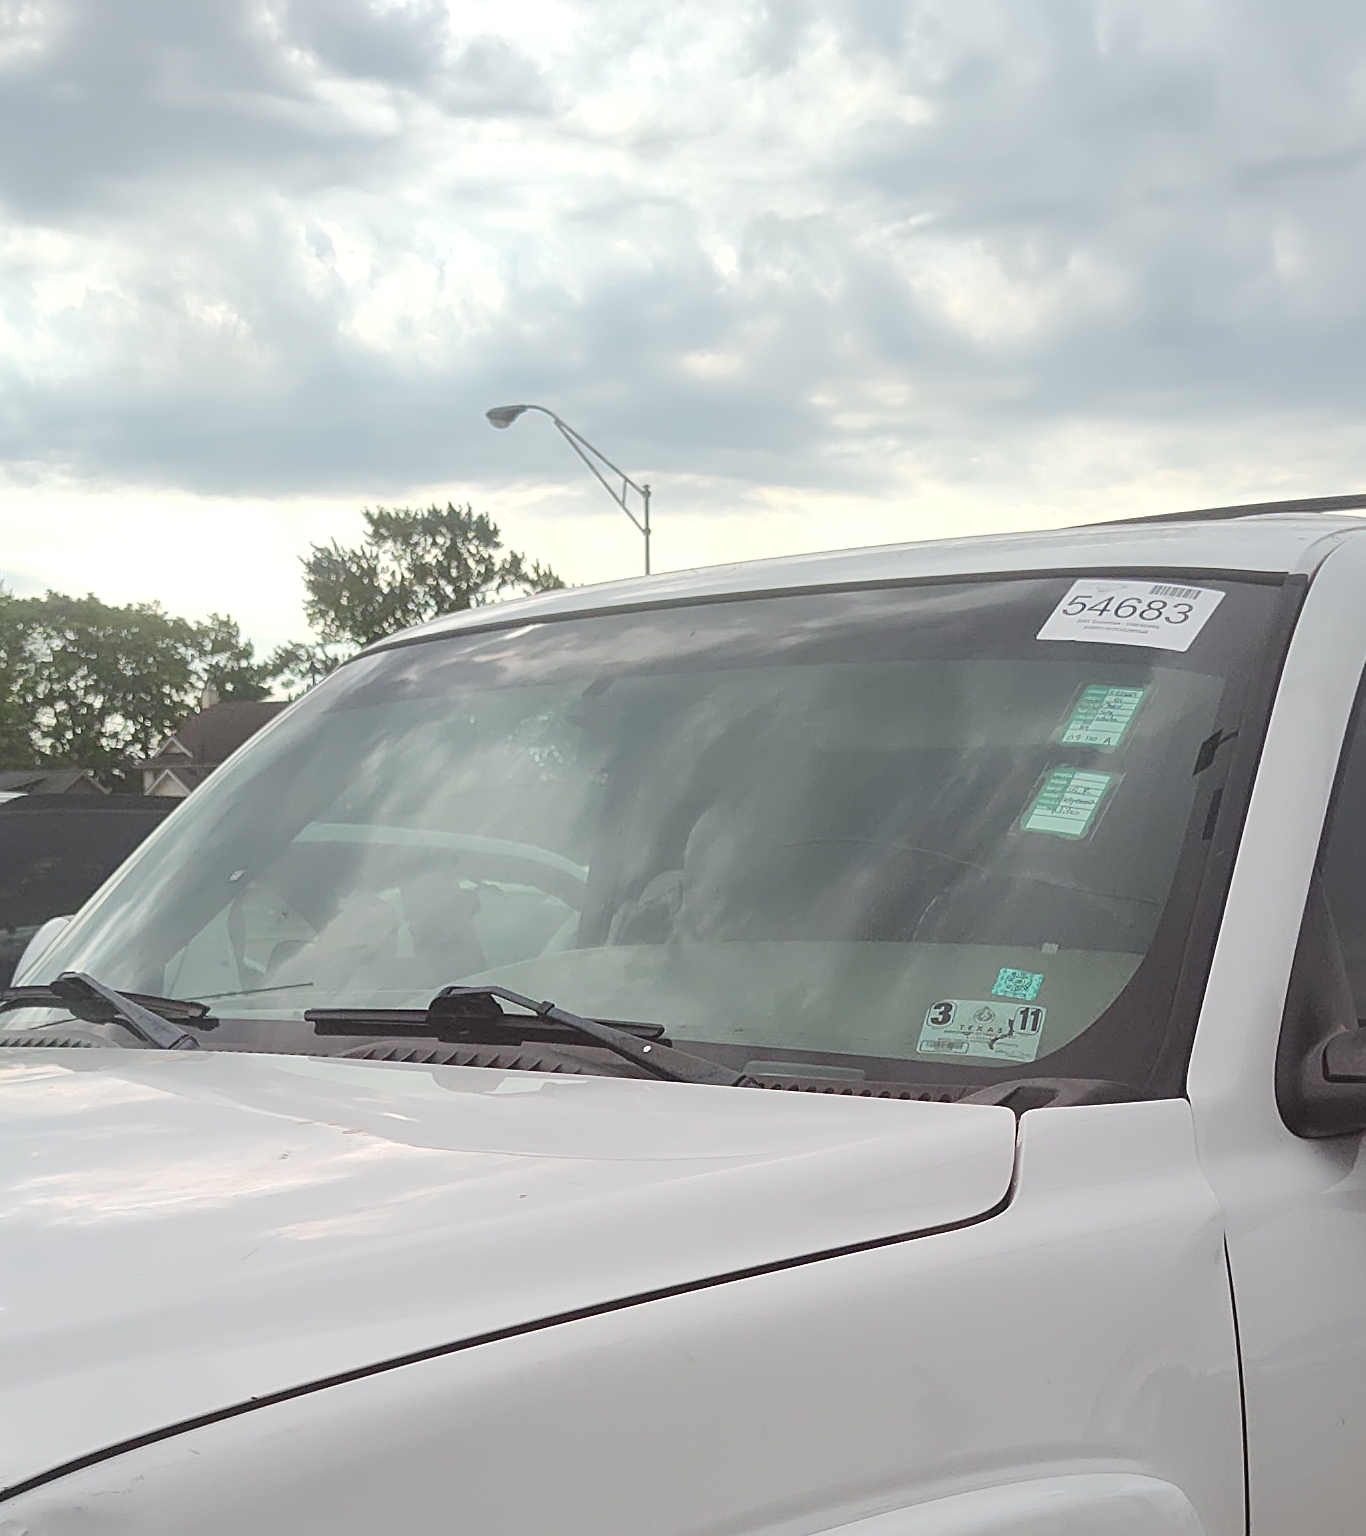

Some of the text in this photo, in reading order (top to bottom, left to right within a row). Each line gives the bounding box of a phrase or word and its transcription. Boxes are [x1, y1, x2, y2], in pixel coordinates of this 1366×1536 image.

[1062, 595, 1194, 625] 54683
[930, 1001, 953, 1026] 3
[1019, 1006, 1041, 1032] 11
[959, 1024, 1003, 1034] TEXAS
